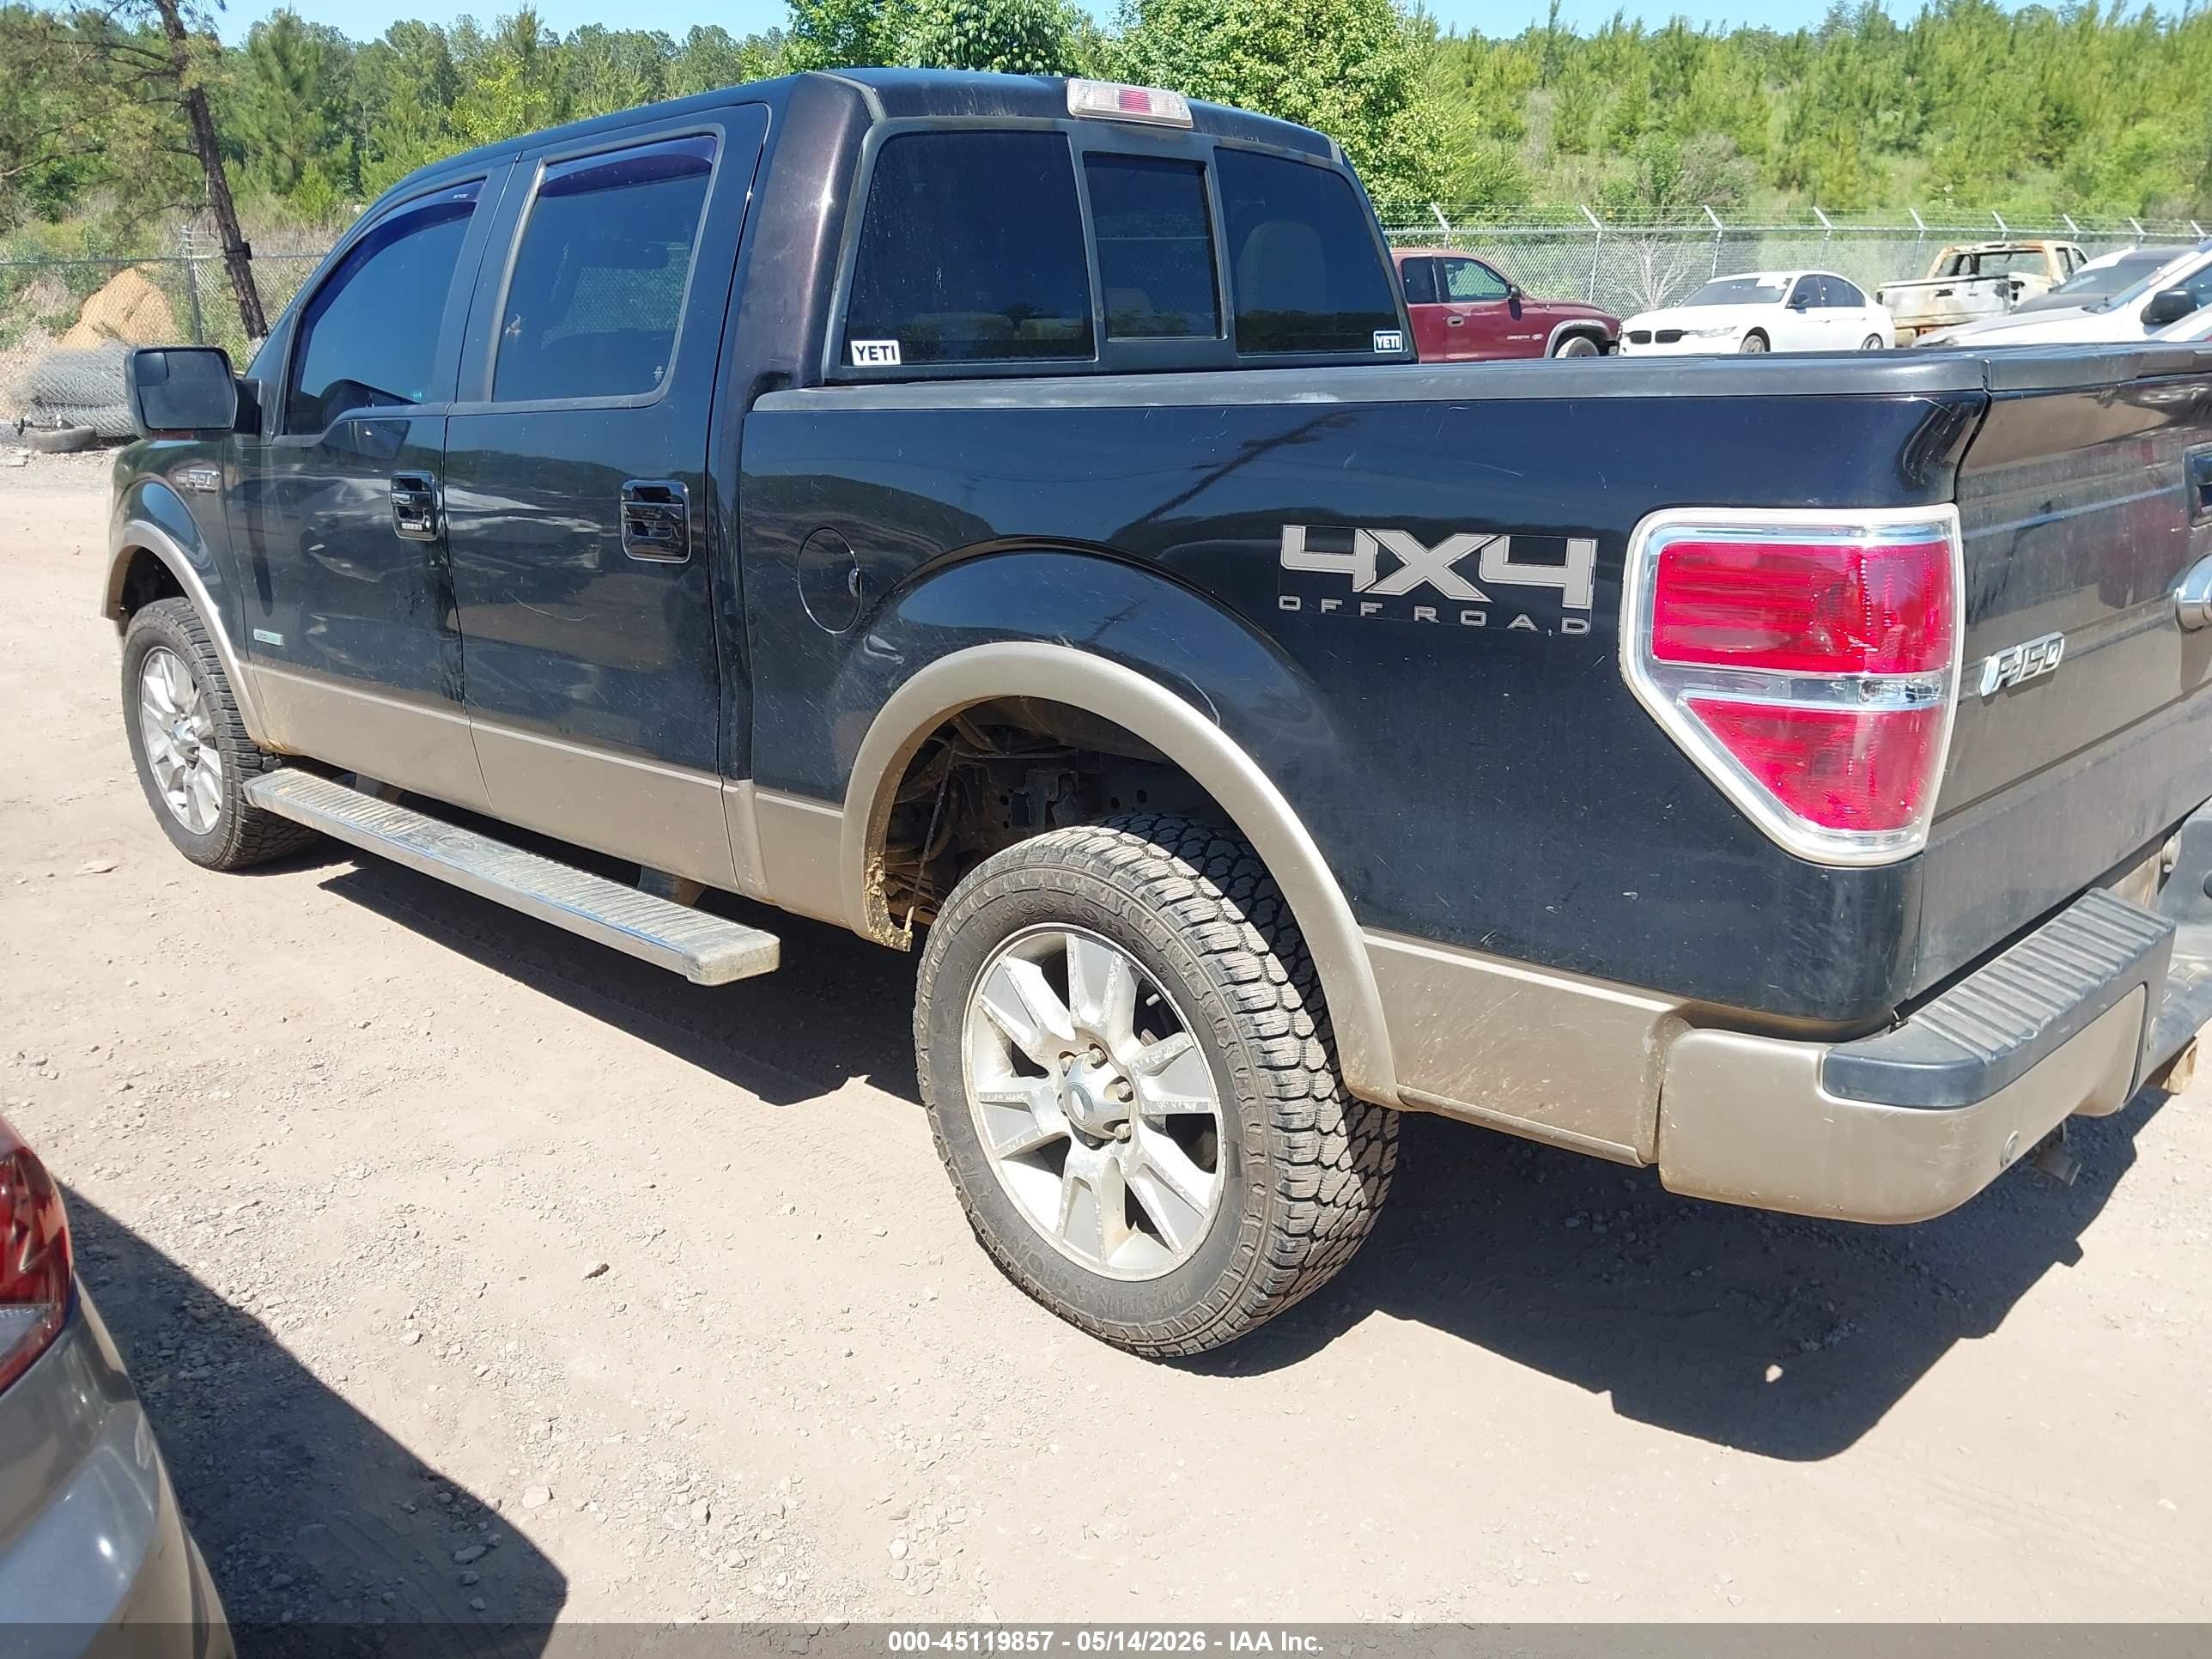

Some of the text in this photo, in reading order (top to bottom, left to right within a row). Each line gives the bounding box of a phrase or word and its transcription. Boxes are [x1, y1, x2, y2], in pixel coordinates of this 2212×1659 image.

[854, 345, 896, 362] YETI
[1376, 335, 1400, 349] YETI
[1279, 524, 1599, 610] 4X4
[1278, 594, 1591, 635] OFF ROAD
